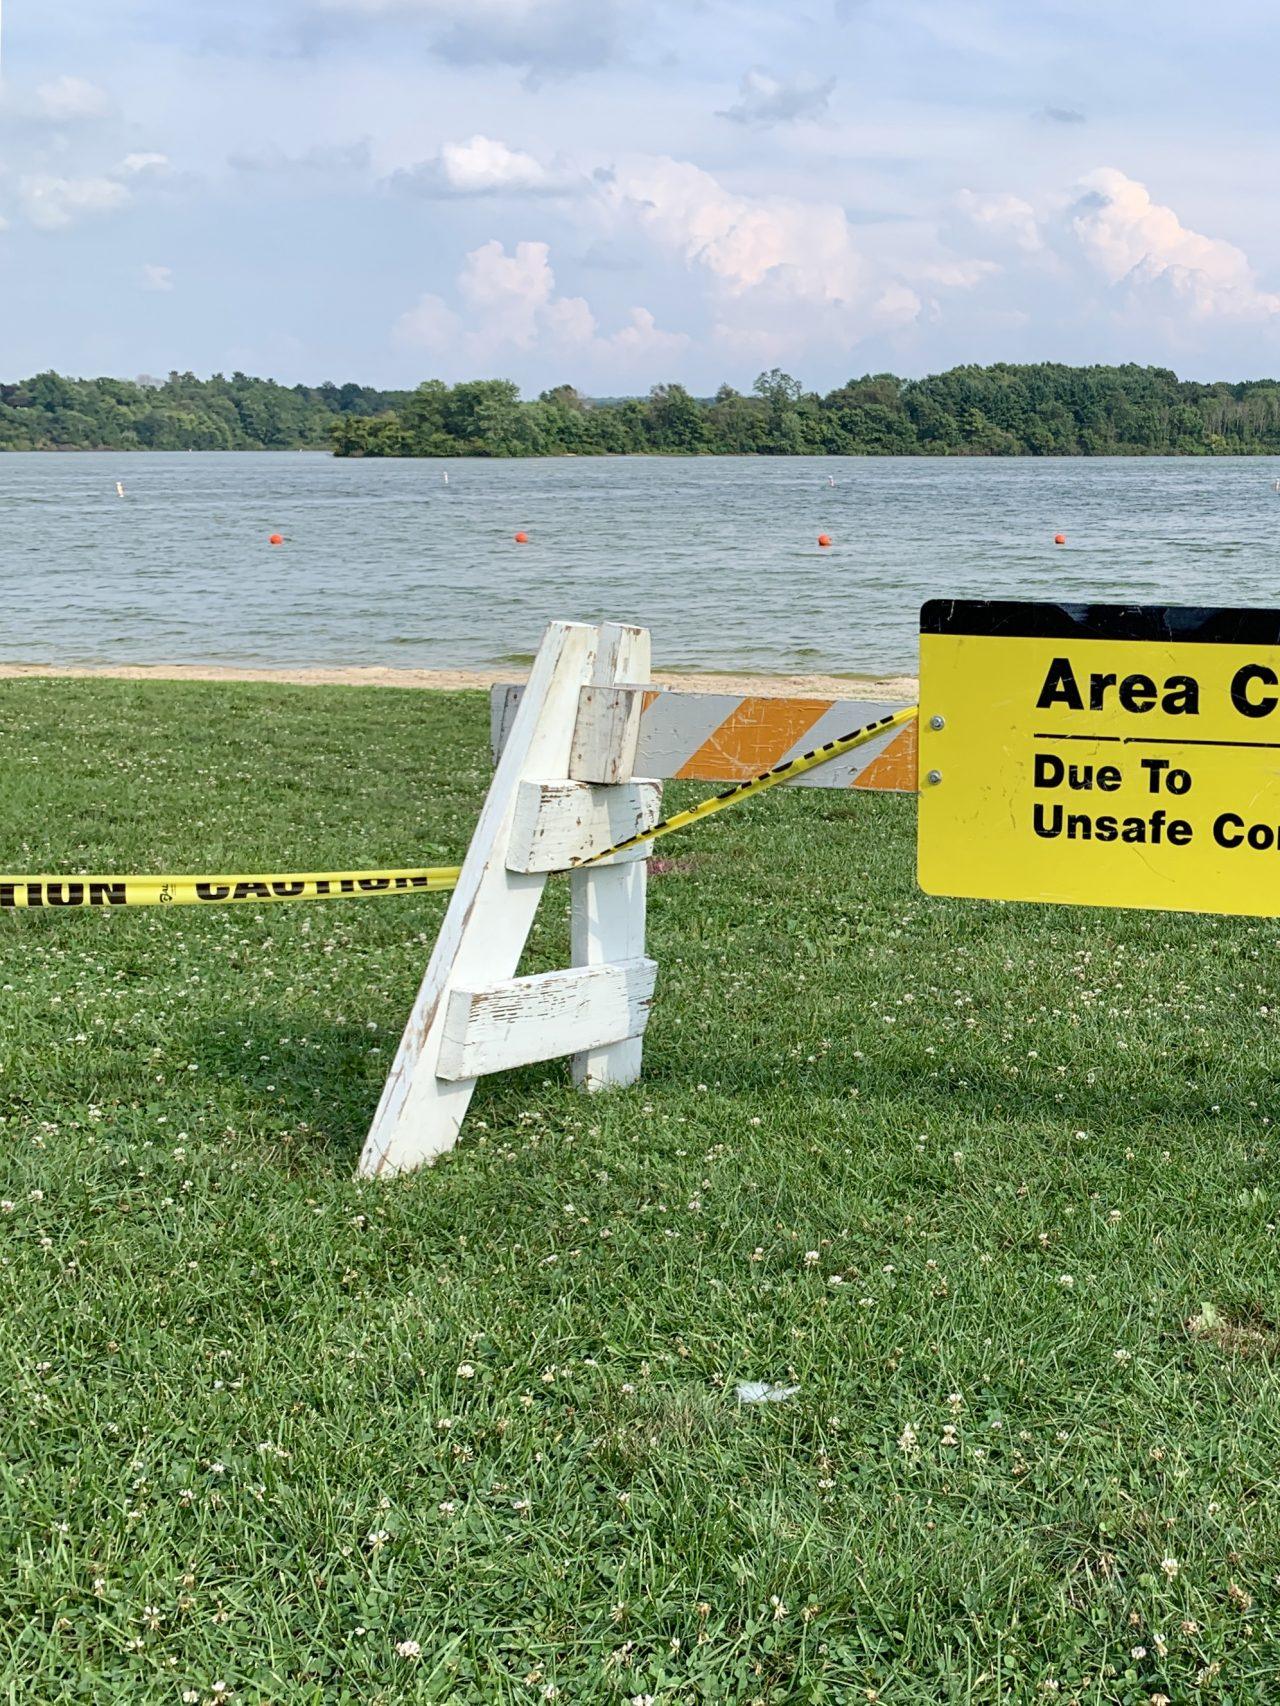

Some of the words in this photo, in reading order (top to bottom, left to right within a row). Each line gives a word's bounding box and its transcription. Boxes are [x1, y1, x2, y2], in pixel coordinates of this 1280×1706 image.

[1035, 657, 1200, 715] Area
[1034, 753, 1122, 792] Due
[1140, 758, 1192, 796] To
[1033, 803, 1193, 846] Unsafe
